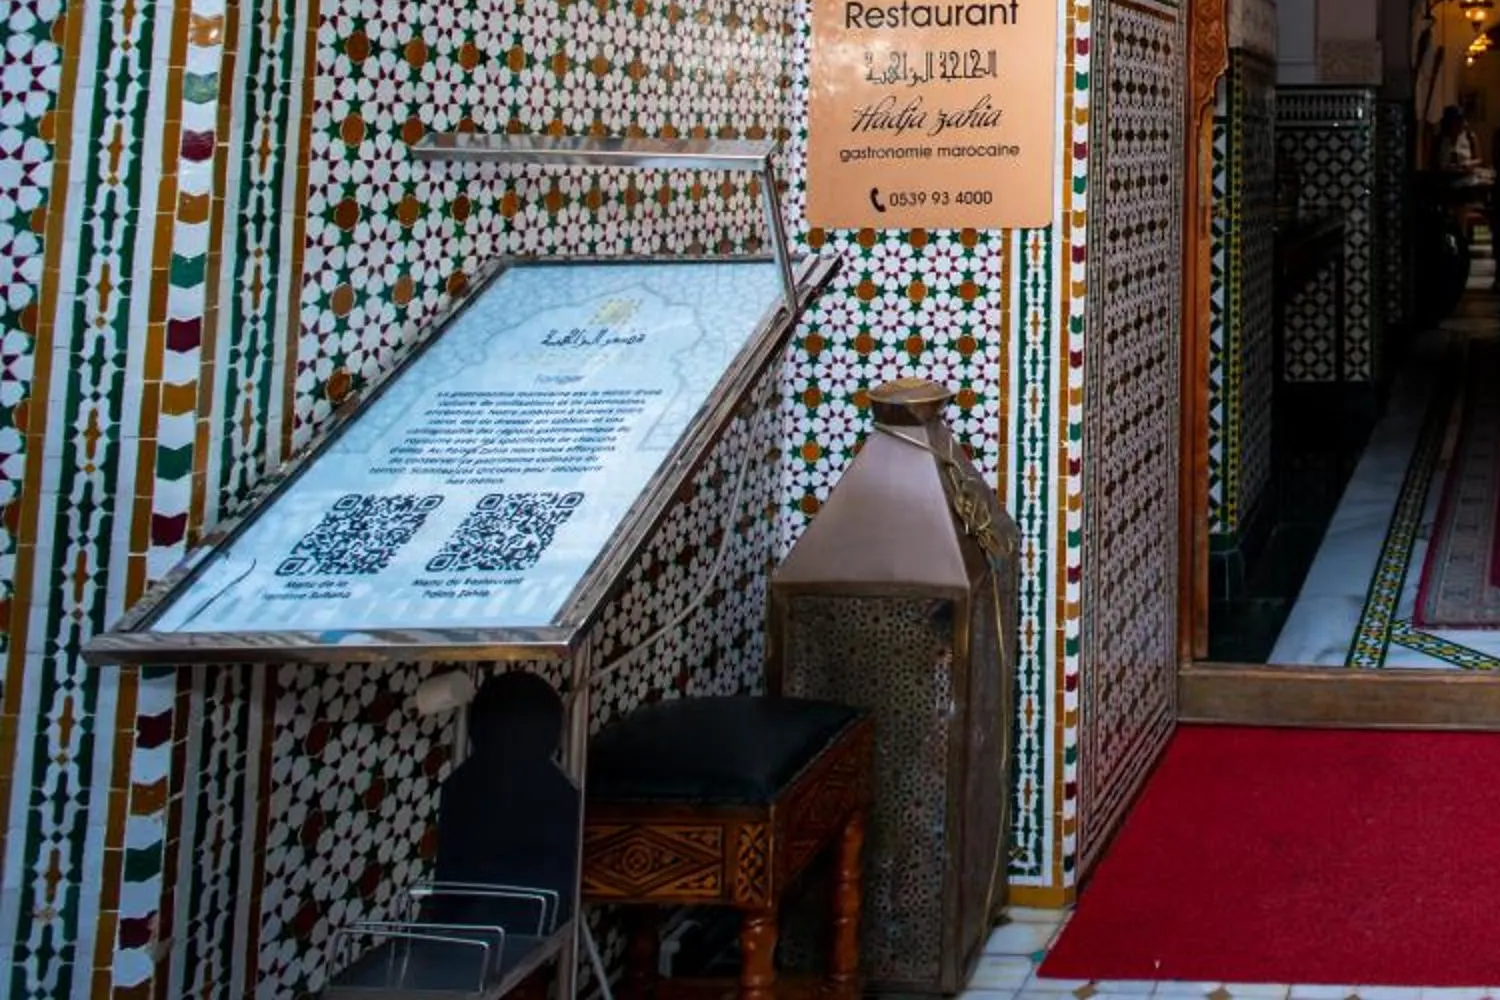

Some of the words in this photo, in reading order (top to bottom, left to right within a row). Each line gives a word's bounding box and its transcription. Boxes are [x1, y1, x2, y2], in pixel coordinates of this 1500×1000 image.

[851, 94, 927, 136] Hadja
[927, 94, 1003, 137] zahia
[840, 145, 933, 162] gastronomie
[937, 144, 1020, 158] marocaine
[890, 192, 927, 207] 0539
[931, 192, 950, 206] 93
[955, 191, 993, 206] 4000
